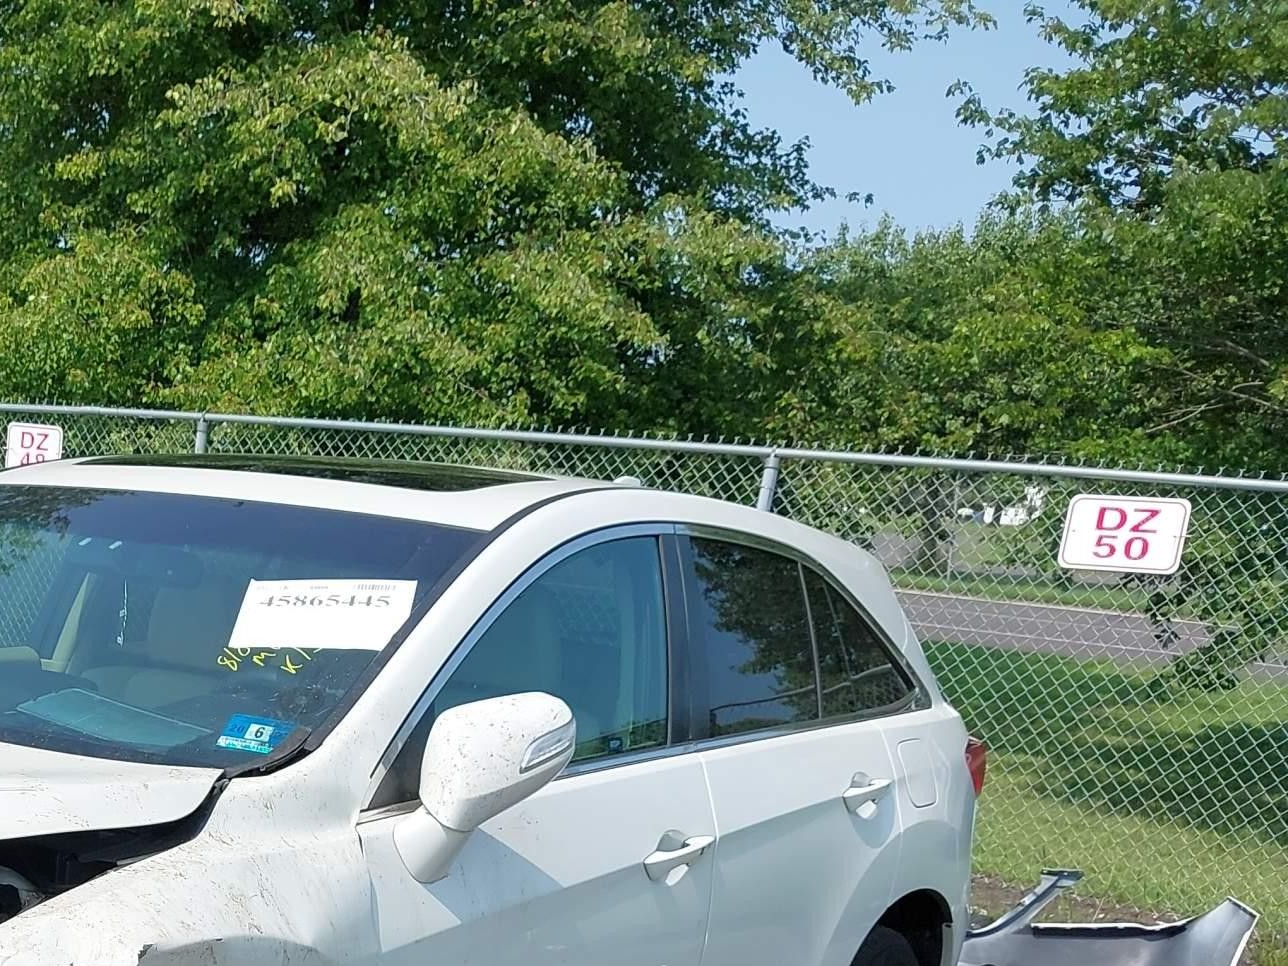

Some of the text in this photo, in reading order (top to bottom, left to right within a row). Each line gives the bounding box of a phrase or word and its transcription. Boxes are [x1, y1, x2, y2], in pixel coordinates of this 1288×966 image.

[21, 431, 49, 451] DZ
[1095, 506, 1161, 533] DZ
[1092, 535, 1149, 561] 50
[259, 594, 392, 608] 45865445
[254, 727, 266, 739] 6
